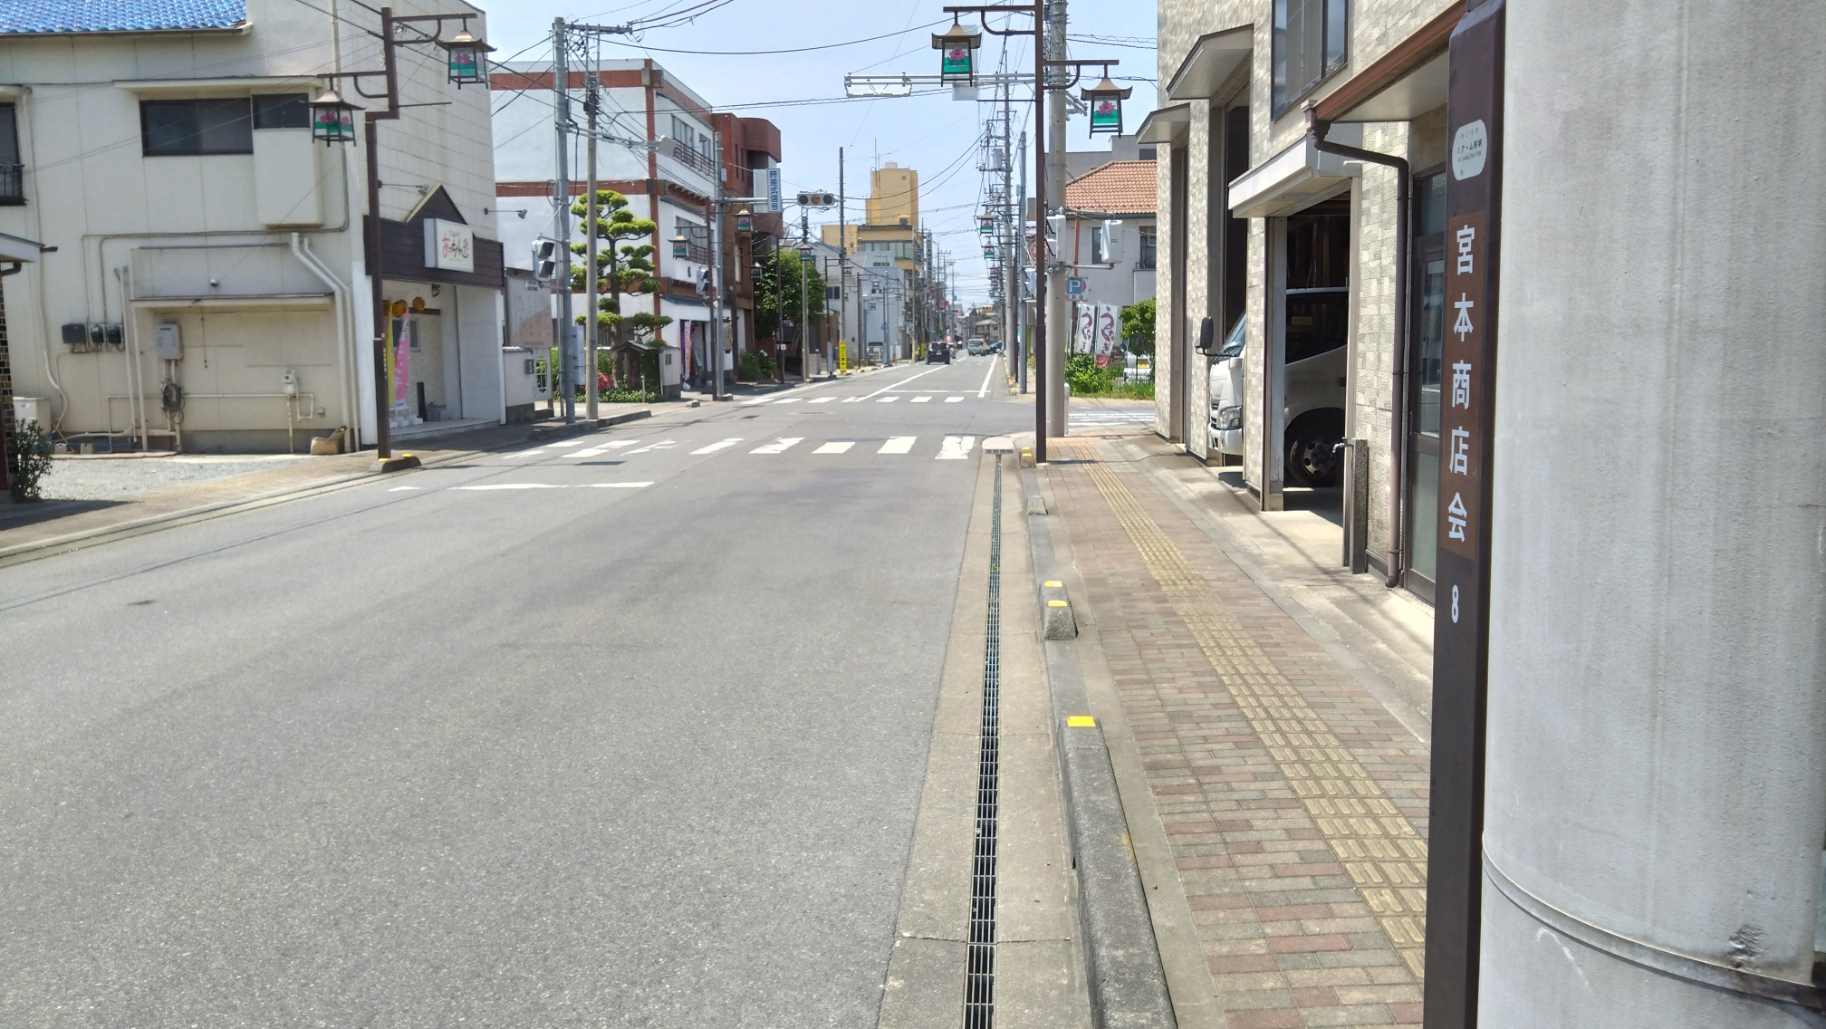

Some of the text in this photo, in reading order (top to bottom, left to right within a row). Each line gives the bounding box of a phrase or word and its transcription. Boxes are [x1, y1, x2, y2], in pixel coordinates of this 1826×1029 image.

[769, 170, 779, 211] 時差式信号
[1069, 280, 1081, 293] P
[1447, 224, 1476, 624] 宮本商店会 8
